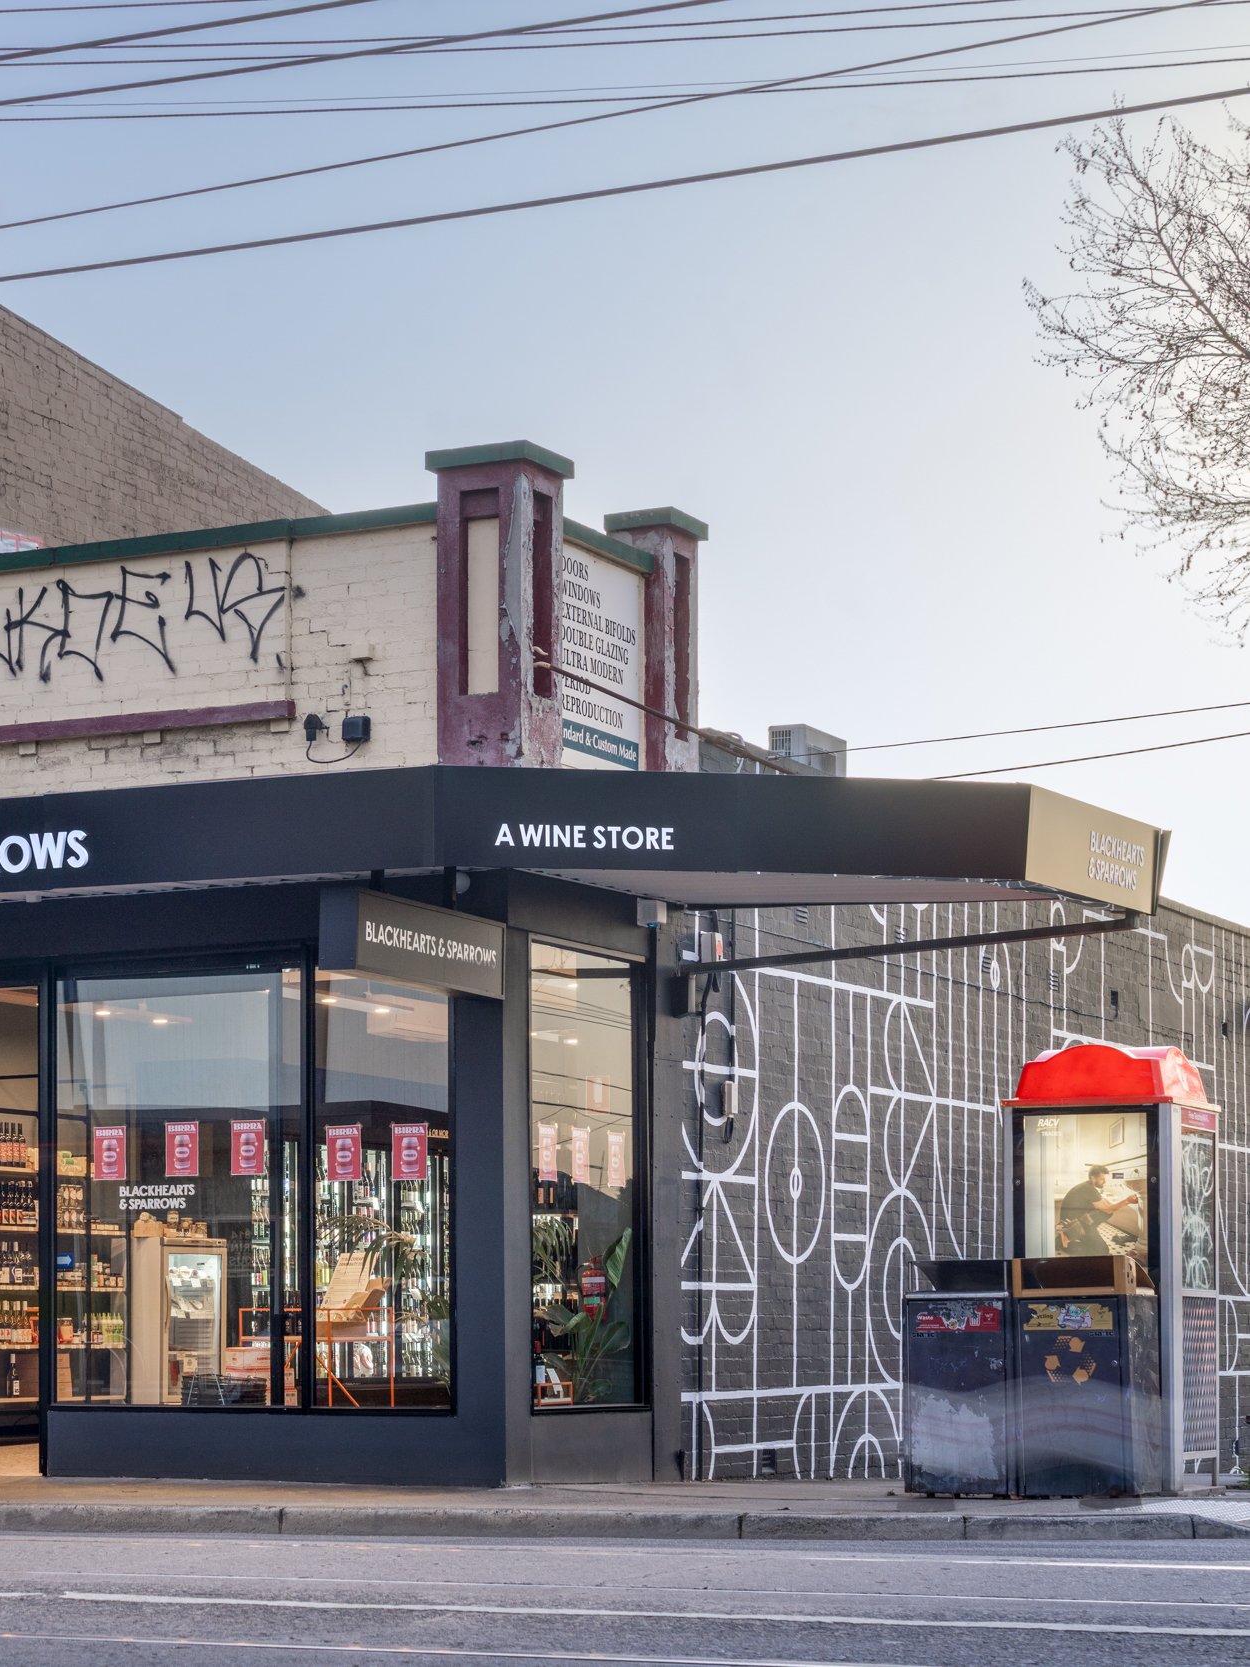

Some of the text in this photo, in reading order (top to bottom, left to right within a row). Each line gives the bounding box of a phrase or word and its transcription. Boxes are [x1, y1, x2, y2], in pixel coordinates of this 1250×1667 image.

[605, 618, 636, 646] BIFOLDS
[595, 637, 629, 665] GLAZING
[590, 657, 623, 685] MODERN
[562, 673, 591, 695] ERIOD
[592, 734, 618, 755] Custom
[619, 745, 637, 762] Made
[495, 823, 675, 850] A WINE STORE
[1090, 831, 1145, 867] BLACKHEARTS
[1088, 857, 1138, 890] & SPARROWS
[365, 920, 497, 968] BLACKHEARTS & SPARROWS
[96, 1128, 123, 1137] BIRRA
[168, 1124, 196, 1132] BIRRA
[233, 1122, 262, 1131] BIRRA
[329, 1127, 358, 1136] BIRRA
[395, 1126, 424, 1135] BIRRA
[1038, 1118, 1059, 1127] RACV
[119, 1184, 195, 1197] BLACKHEARTS
[119, 1198, 186, 1210] & SPARROWS
